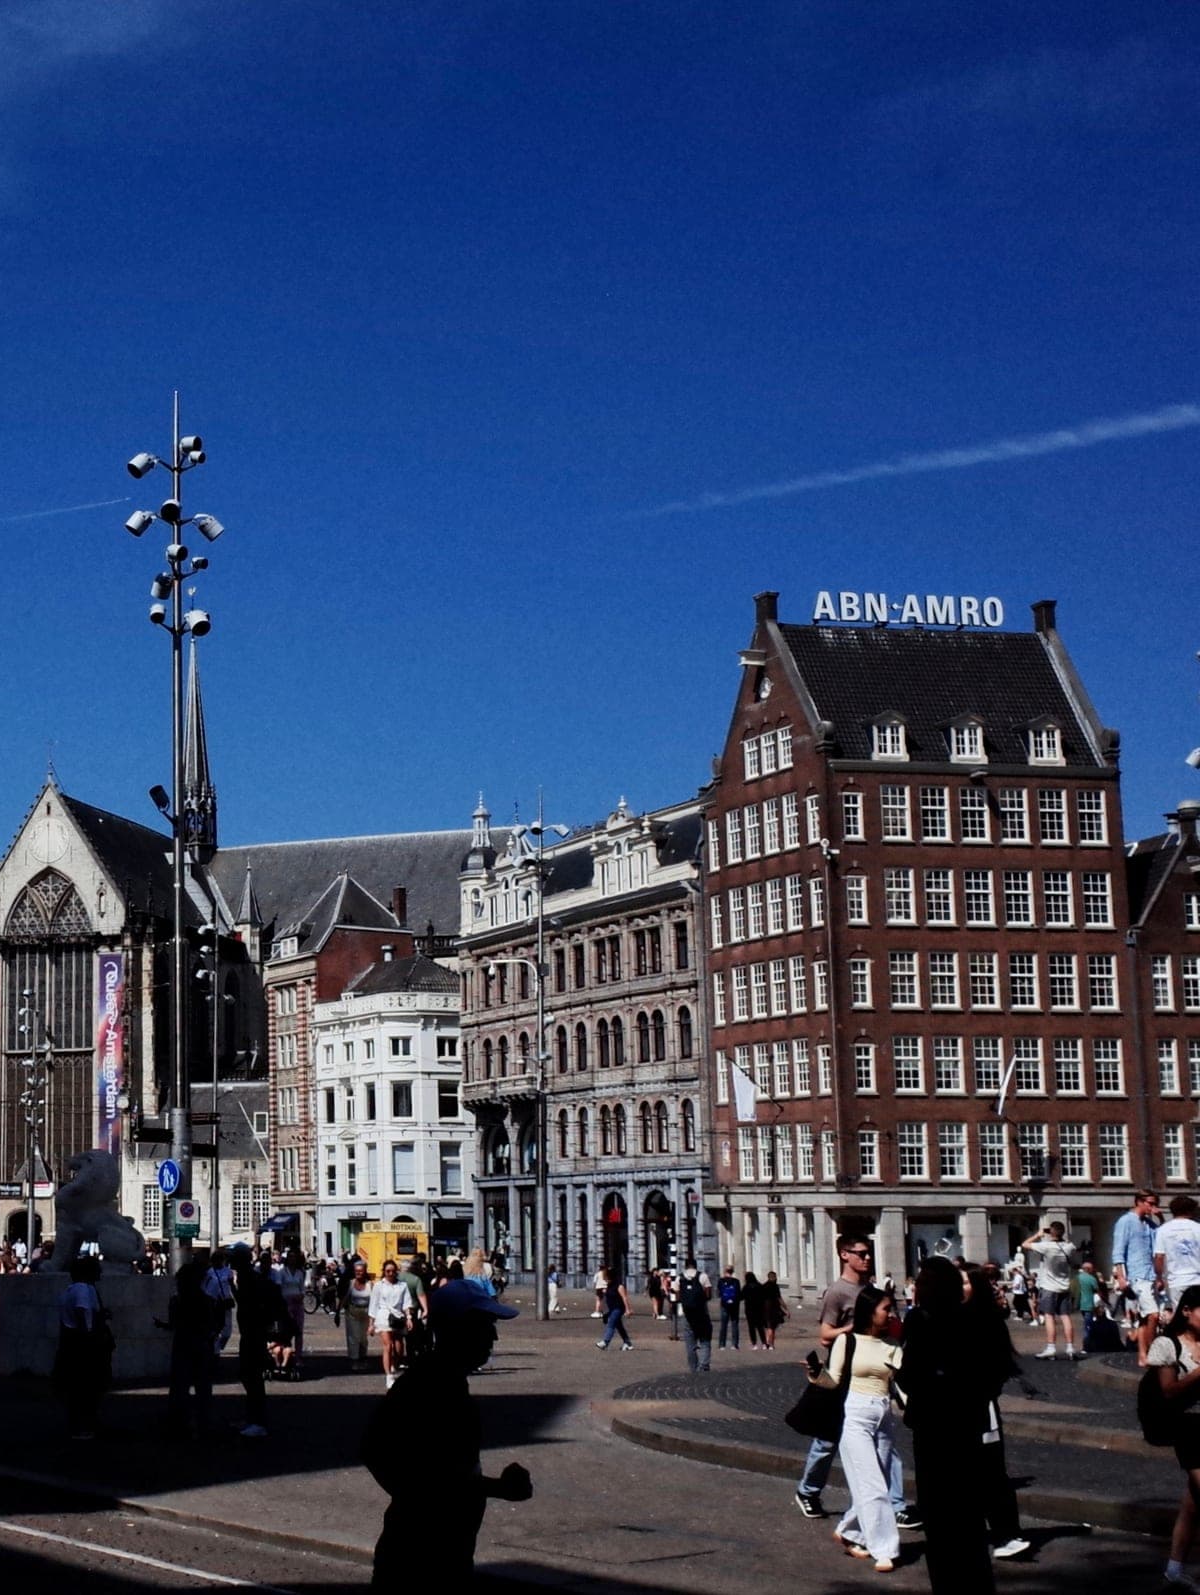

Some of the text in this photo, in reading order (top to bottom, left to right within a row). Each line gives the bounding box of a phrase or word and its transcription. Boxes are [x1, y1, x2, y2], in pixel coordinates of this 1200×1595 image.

[813, 590, 1004, 627] ABN AMRO
[103, 1027, 119, 1119] Amsterdam
